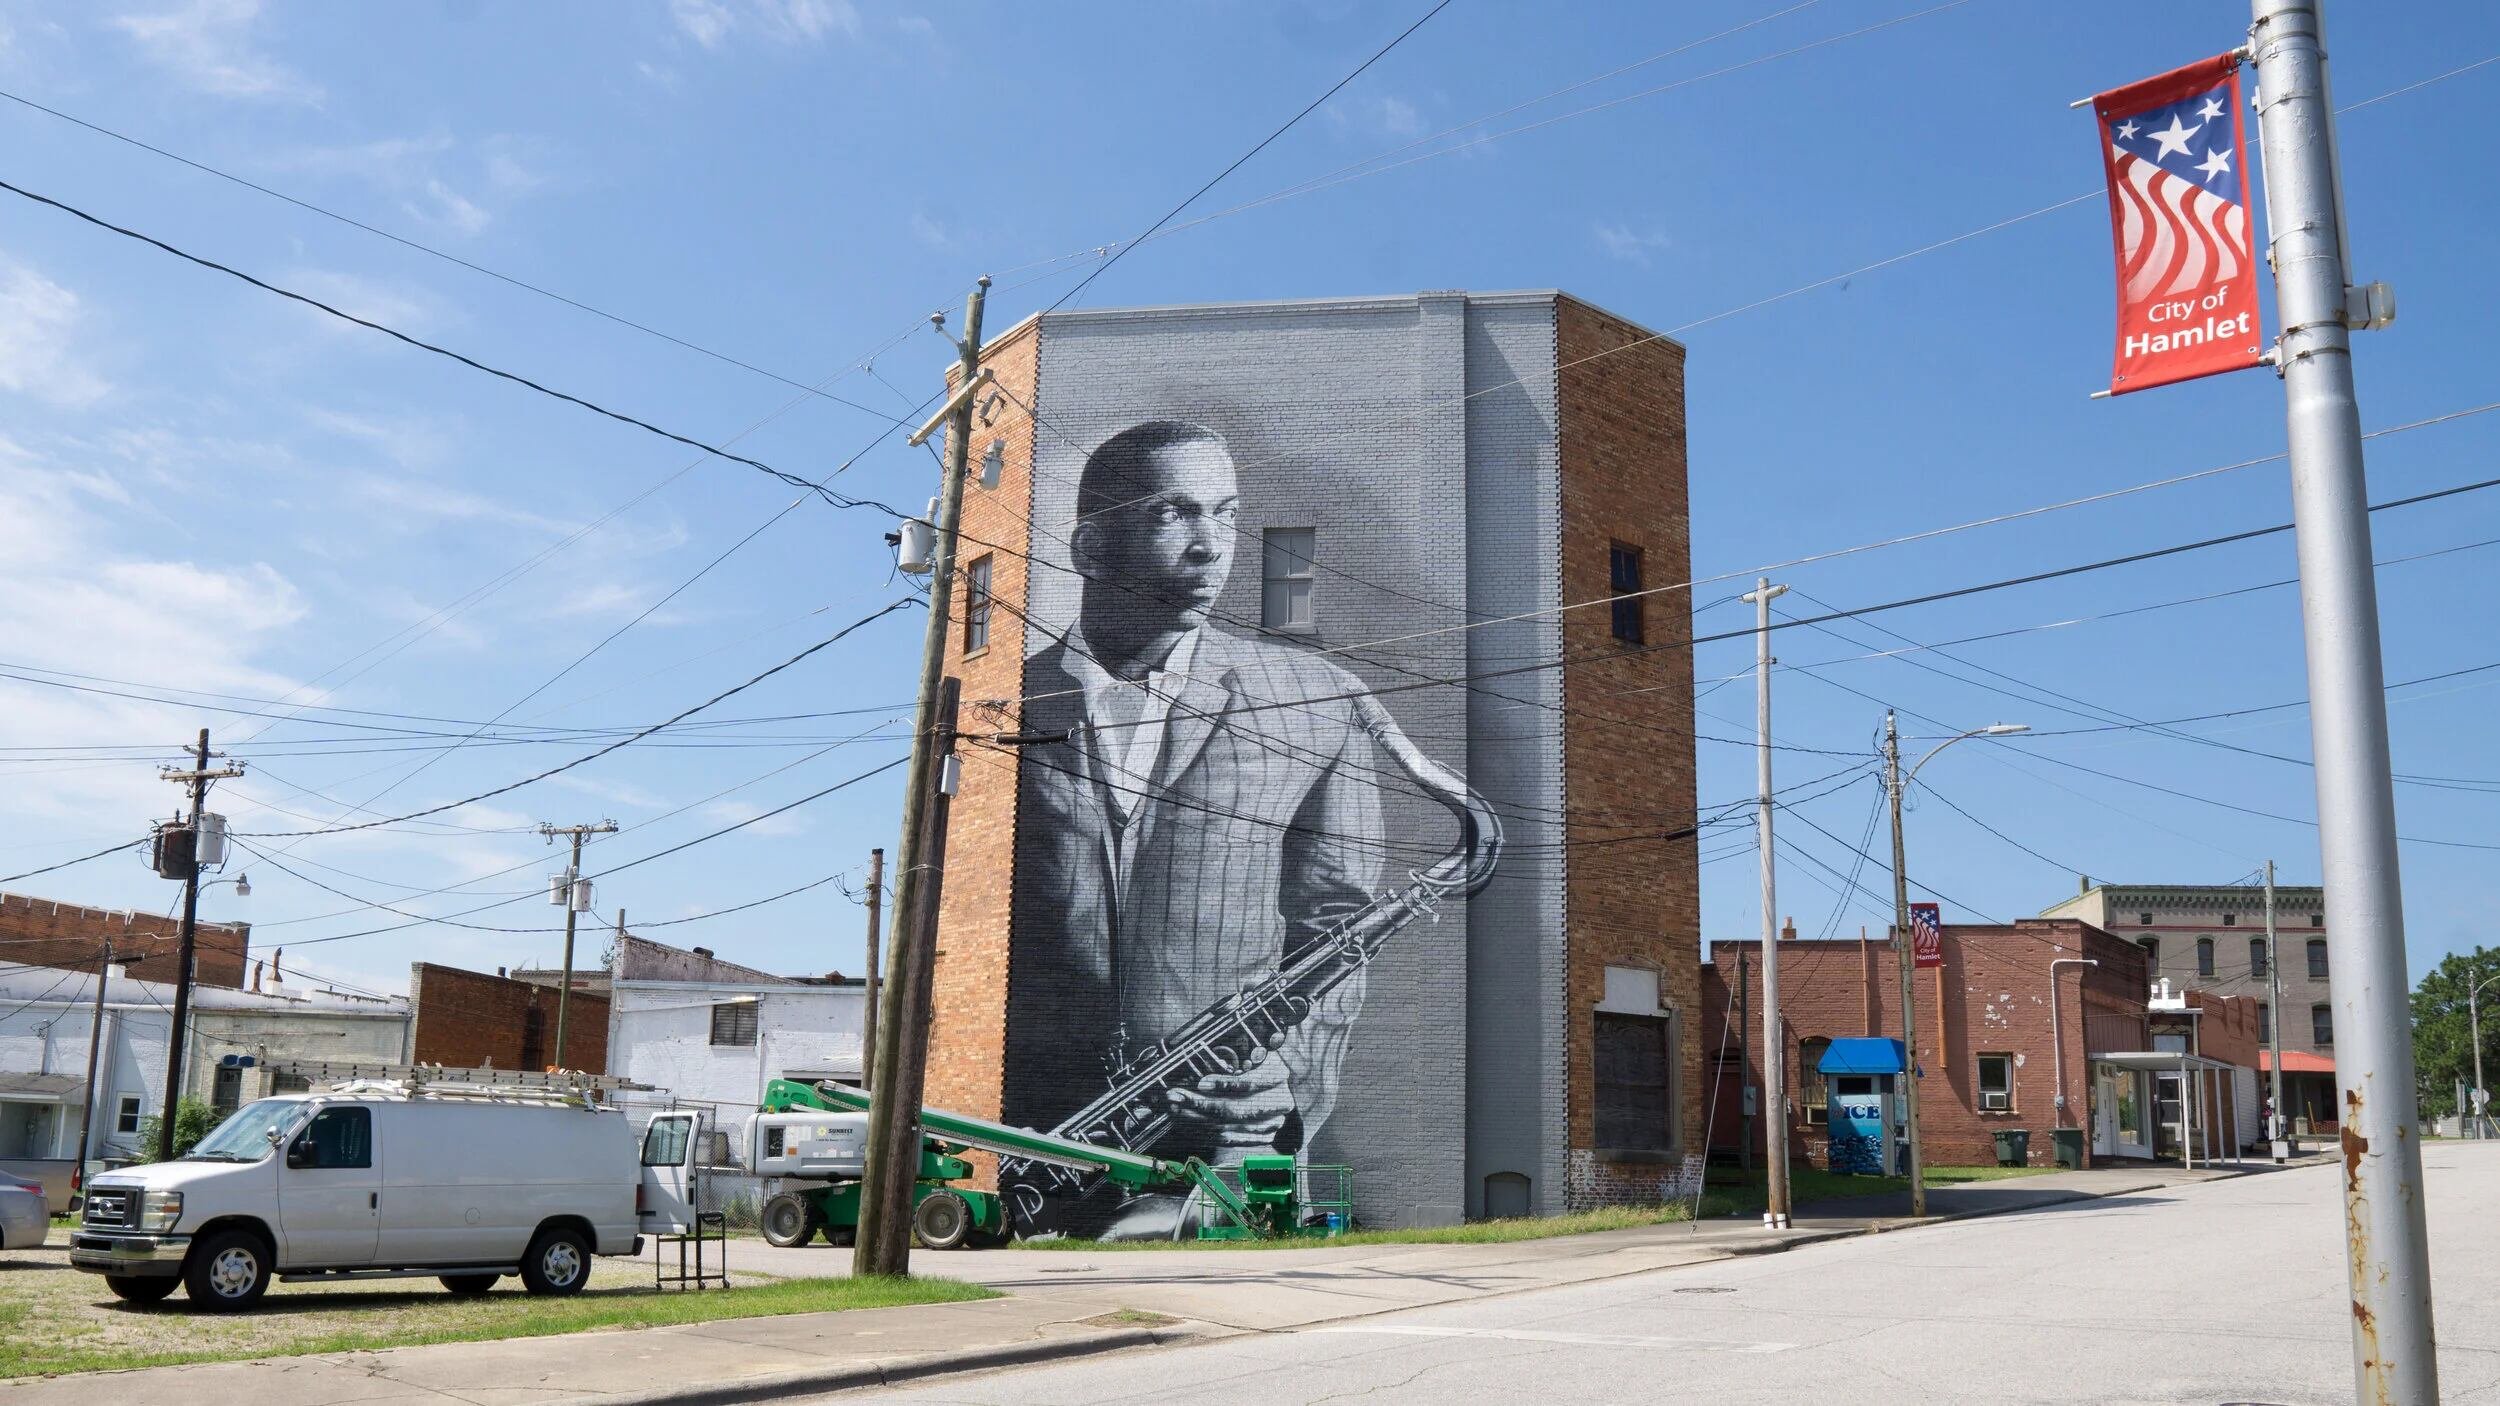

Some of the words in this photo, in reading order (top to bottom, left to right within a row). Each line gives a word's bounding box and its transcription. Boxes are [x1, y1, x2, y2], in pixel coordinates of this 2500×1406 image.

[2148, 300, 2196, 322] City
[2202, 285, 2228, 310] of
[2125, 311, 2250, 358] Hamlet
[1842, 1104, 1880, 1119] ICE
